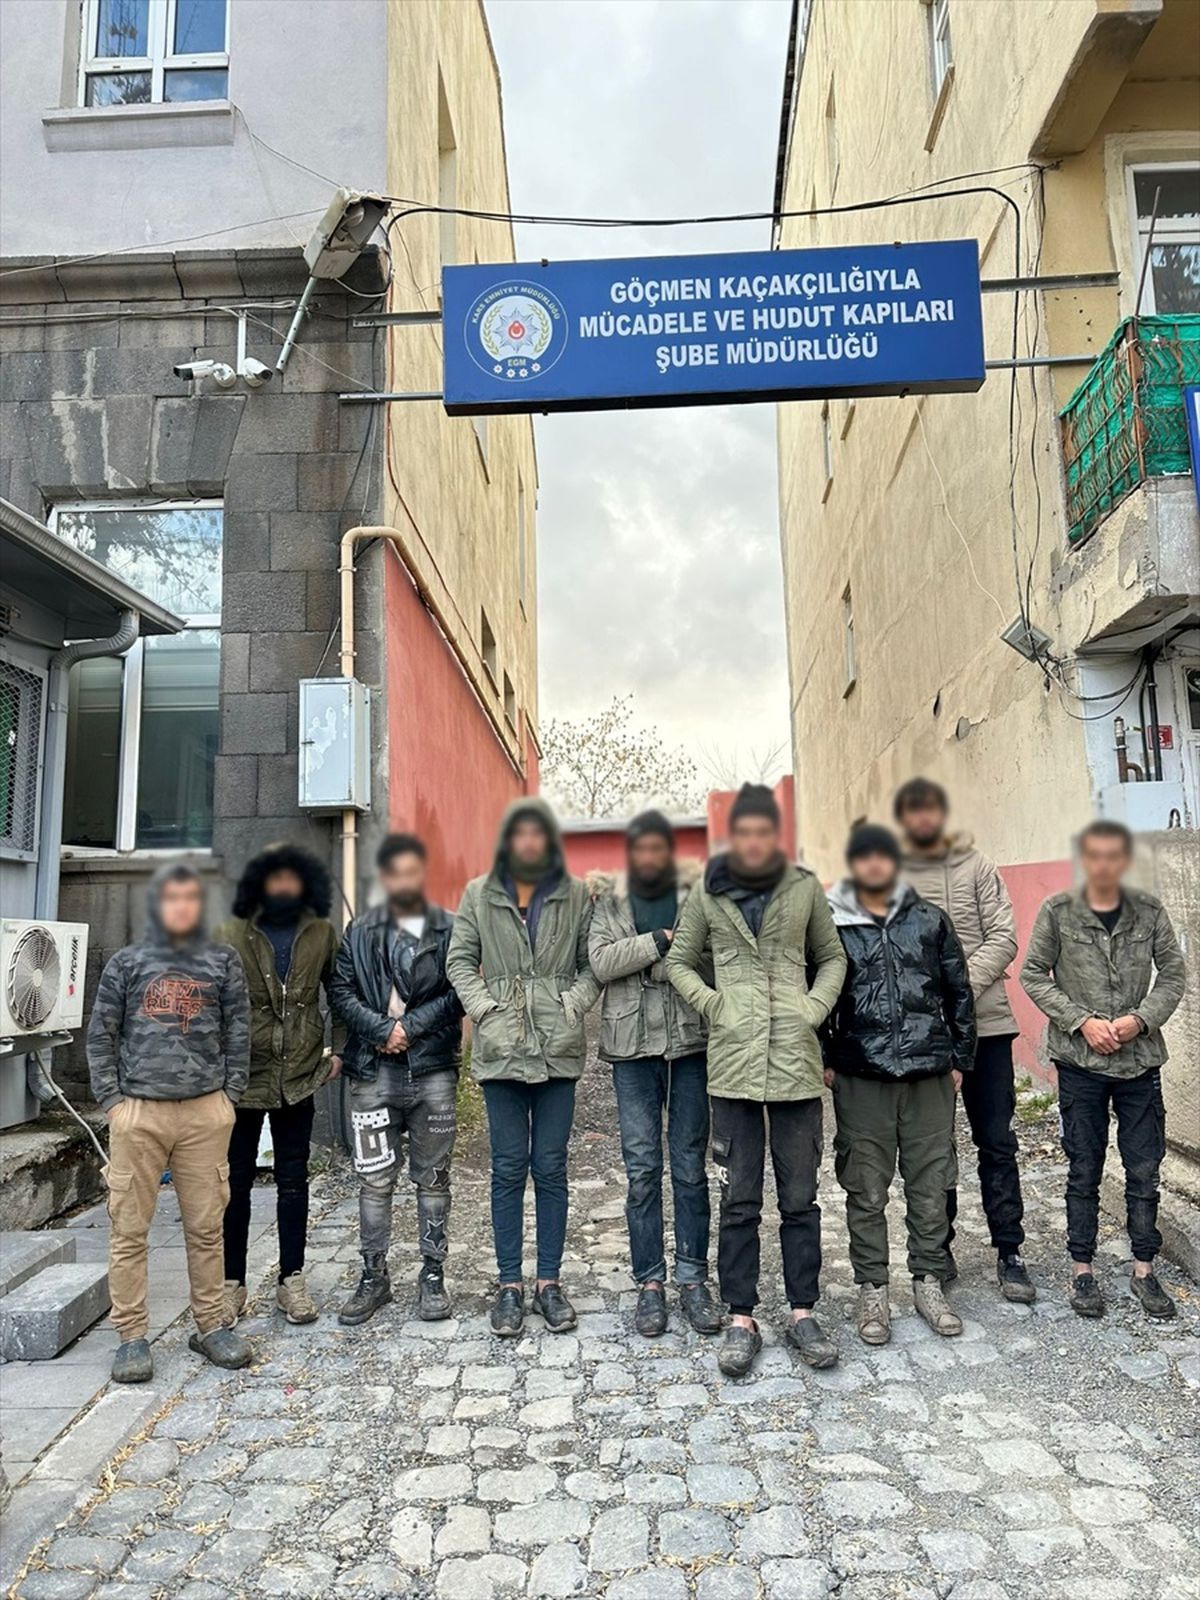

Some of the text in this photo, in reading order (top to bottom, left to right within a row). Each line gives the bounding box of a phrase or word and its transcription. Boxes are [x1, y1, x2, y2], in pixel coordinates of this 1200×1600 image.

[472, 286, 560, 324] KARS EMNİYET MÜDÜRLÜĞÜ
[610, 265, 921, 308] GÖÇMEN KAÇAKÇILIĞIYLA
[579, 299, 955, 338] MÜCADELE VE HUDUT KAPILARI
[507, 359, 526, 367] EGM
[655, 331, 879, 374] ŞUBE MÜDÜRLÜĞÜ
[151, 979, 196, 999] NEW
